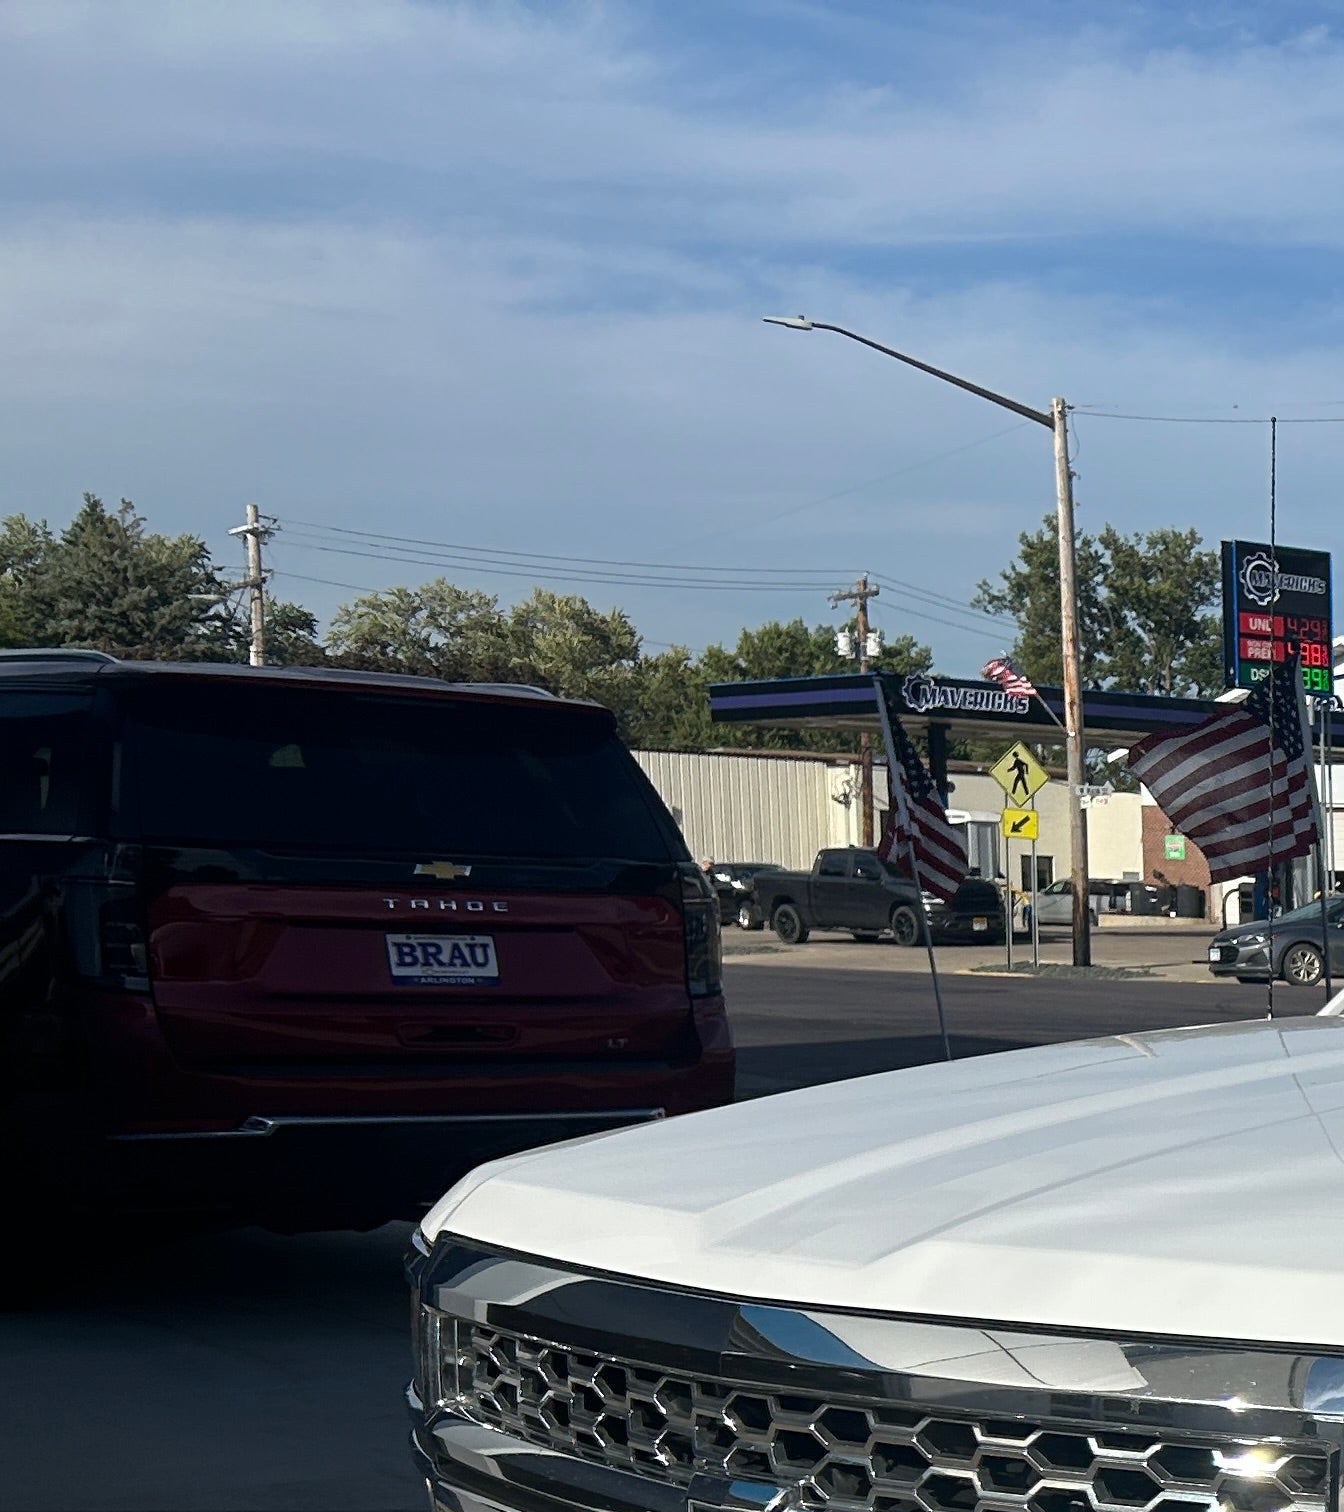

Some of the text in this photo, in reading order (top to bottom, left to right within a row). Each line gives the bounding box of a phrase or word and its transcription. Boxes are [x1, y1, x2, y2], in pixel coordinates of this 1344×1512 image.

[1249, 617, 1272, 632] UNL
[1250, 668, 1270, 682] DS
[383, 898, 508, 912] TAHOE
[391, 941, 490, 968] BRAU
